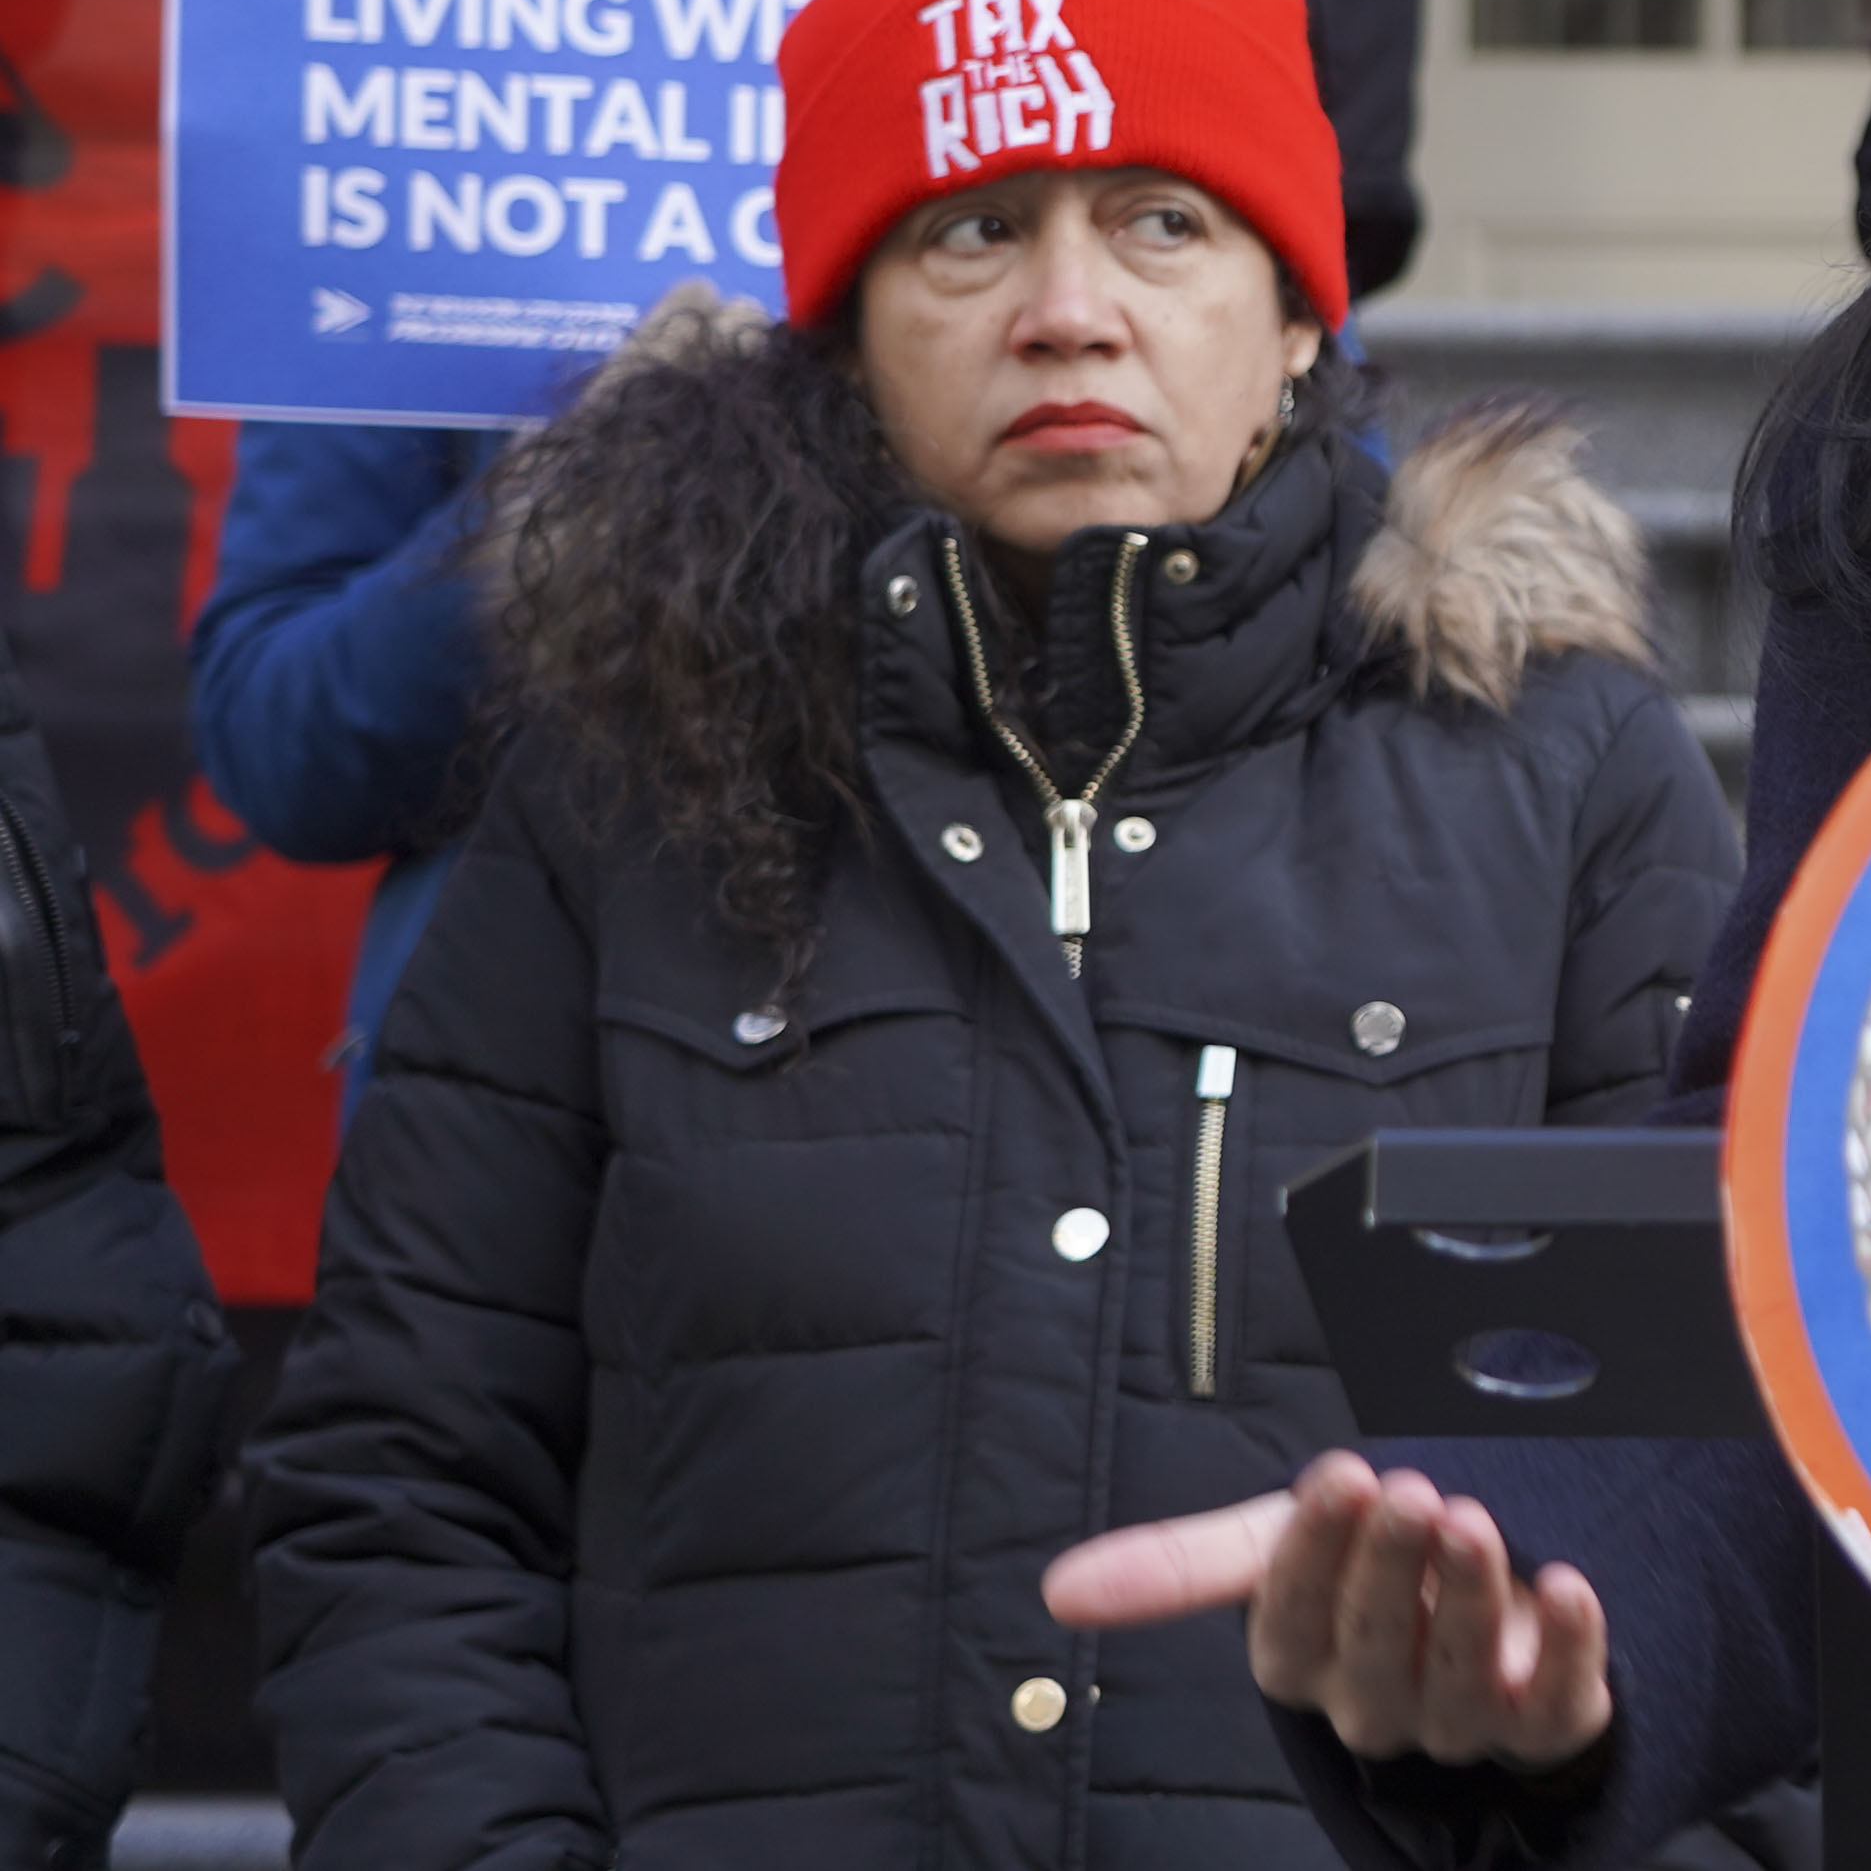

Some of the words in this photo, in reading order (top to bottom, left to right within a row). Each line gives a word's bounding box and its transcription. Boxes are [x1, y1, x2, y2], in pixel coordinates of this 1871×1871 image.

[304, 61, 713, 163] MENTAL
[919, 49, 1116, 180] RICH
[961, 49, 1037, 90] THE
[302, 164, 390, 249] IS
[408, 169, 628, 262] NOT
[638, 180, 717, 264] A
